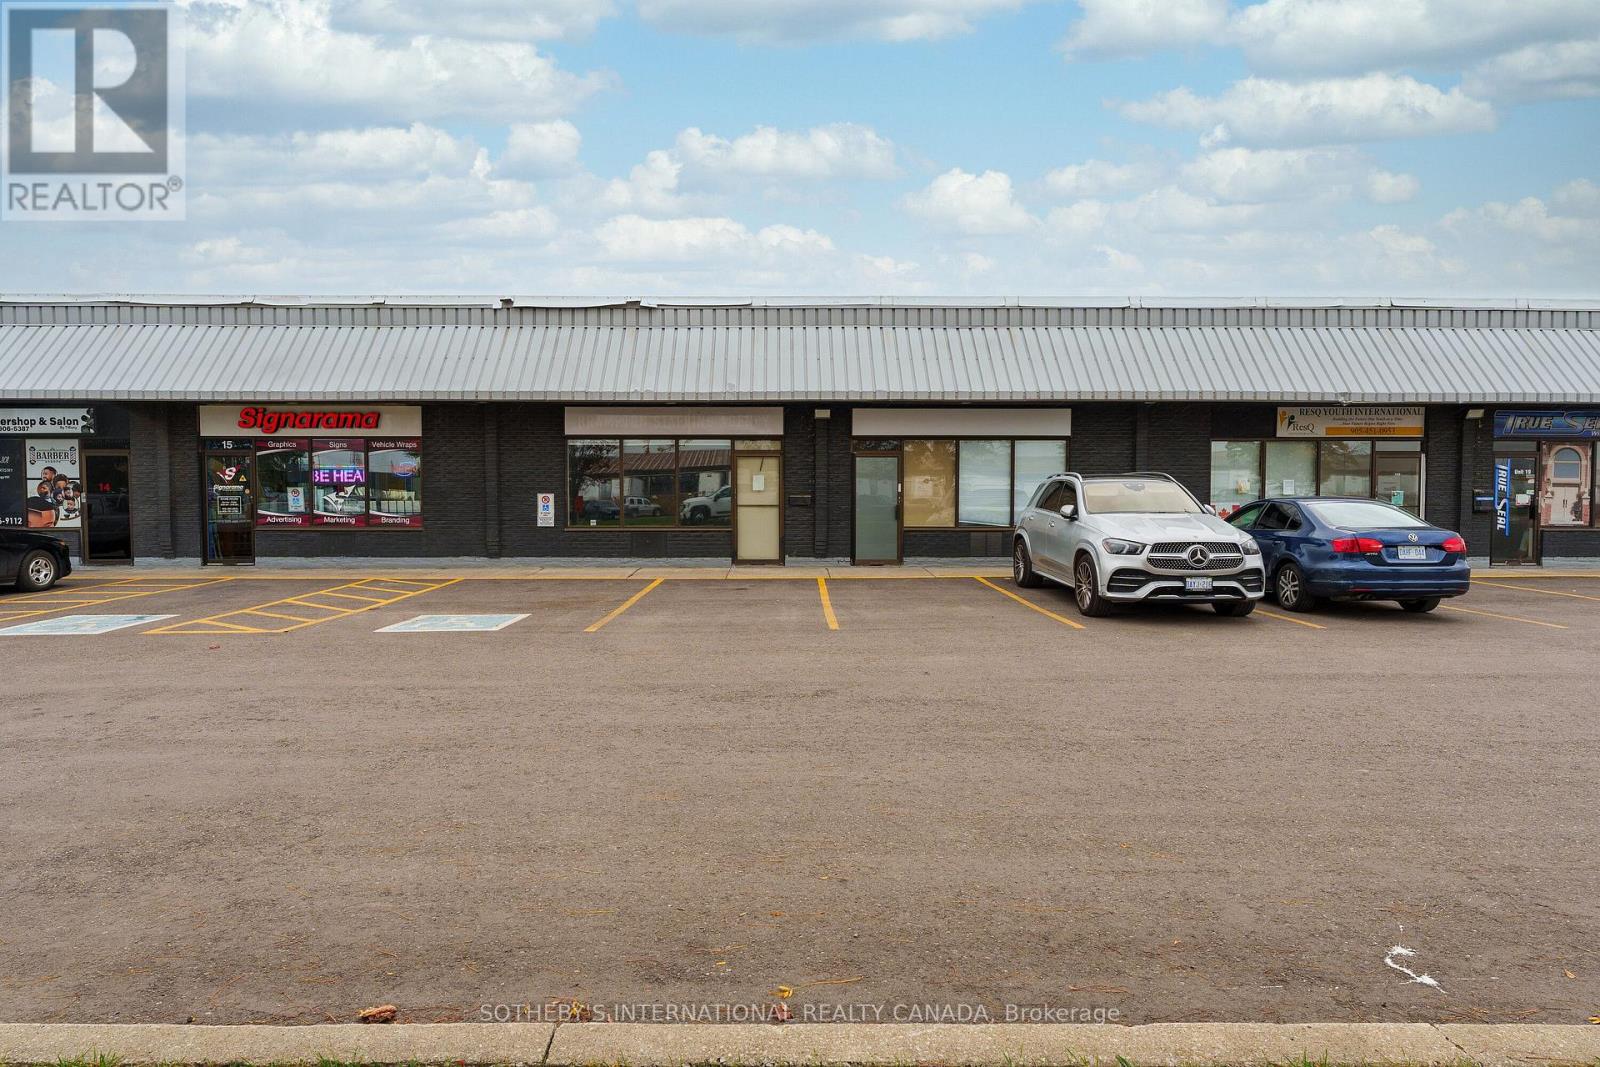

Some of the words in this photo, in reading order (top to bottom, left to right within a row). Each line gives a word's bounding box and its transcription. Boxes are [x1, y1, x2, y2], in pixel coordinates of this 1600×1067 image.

[1299, 408, 1321, 416] RESQ
[1323, 408, 1352, 416] YOUTH
[1354, 408, 1423, 416] INTERNATIONAL
[0, 417, 36, 428] ershop
[39, 417, 47, 426] &
[49, 417, 79, 426] Salon
[238, 407, 380, 434] Signarama
[1498, 411, 1552, 434] TRUE
[1293, 423, 1315, 433] ResQ
[222, 440, 233, 449] 15
[267, 440, 297, 448] Graphics
[328, 441, 348, 449] Signs
[36, 451, 70, 460] BARBER
[1496, 464, 1509, 492] TRUE
[1496, 498, 1508, 530] SEAL
[266, 516, 302, 524] Advertising
[323, 516, 355, 524] Marketing
[381, 516, 409, 524] Branding
